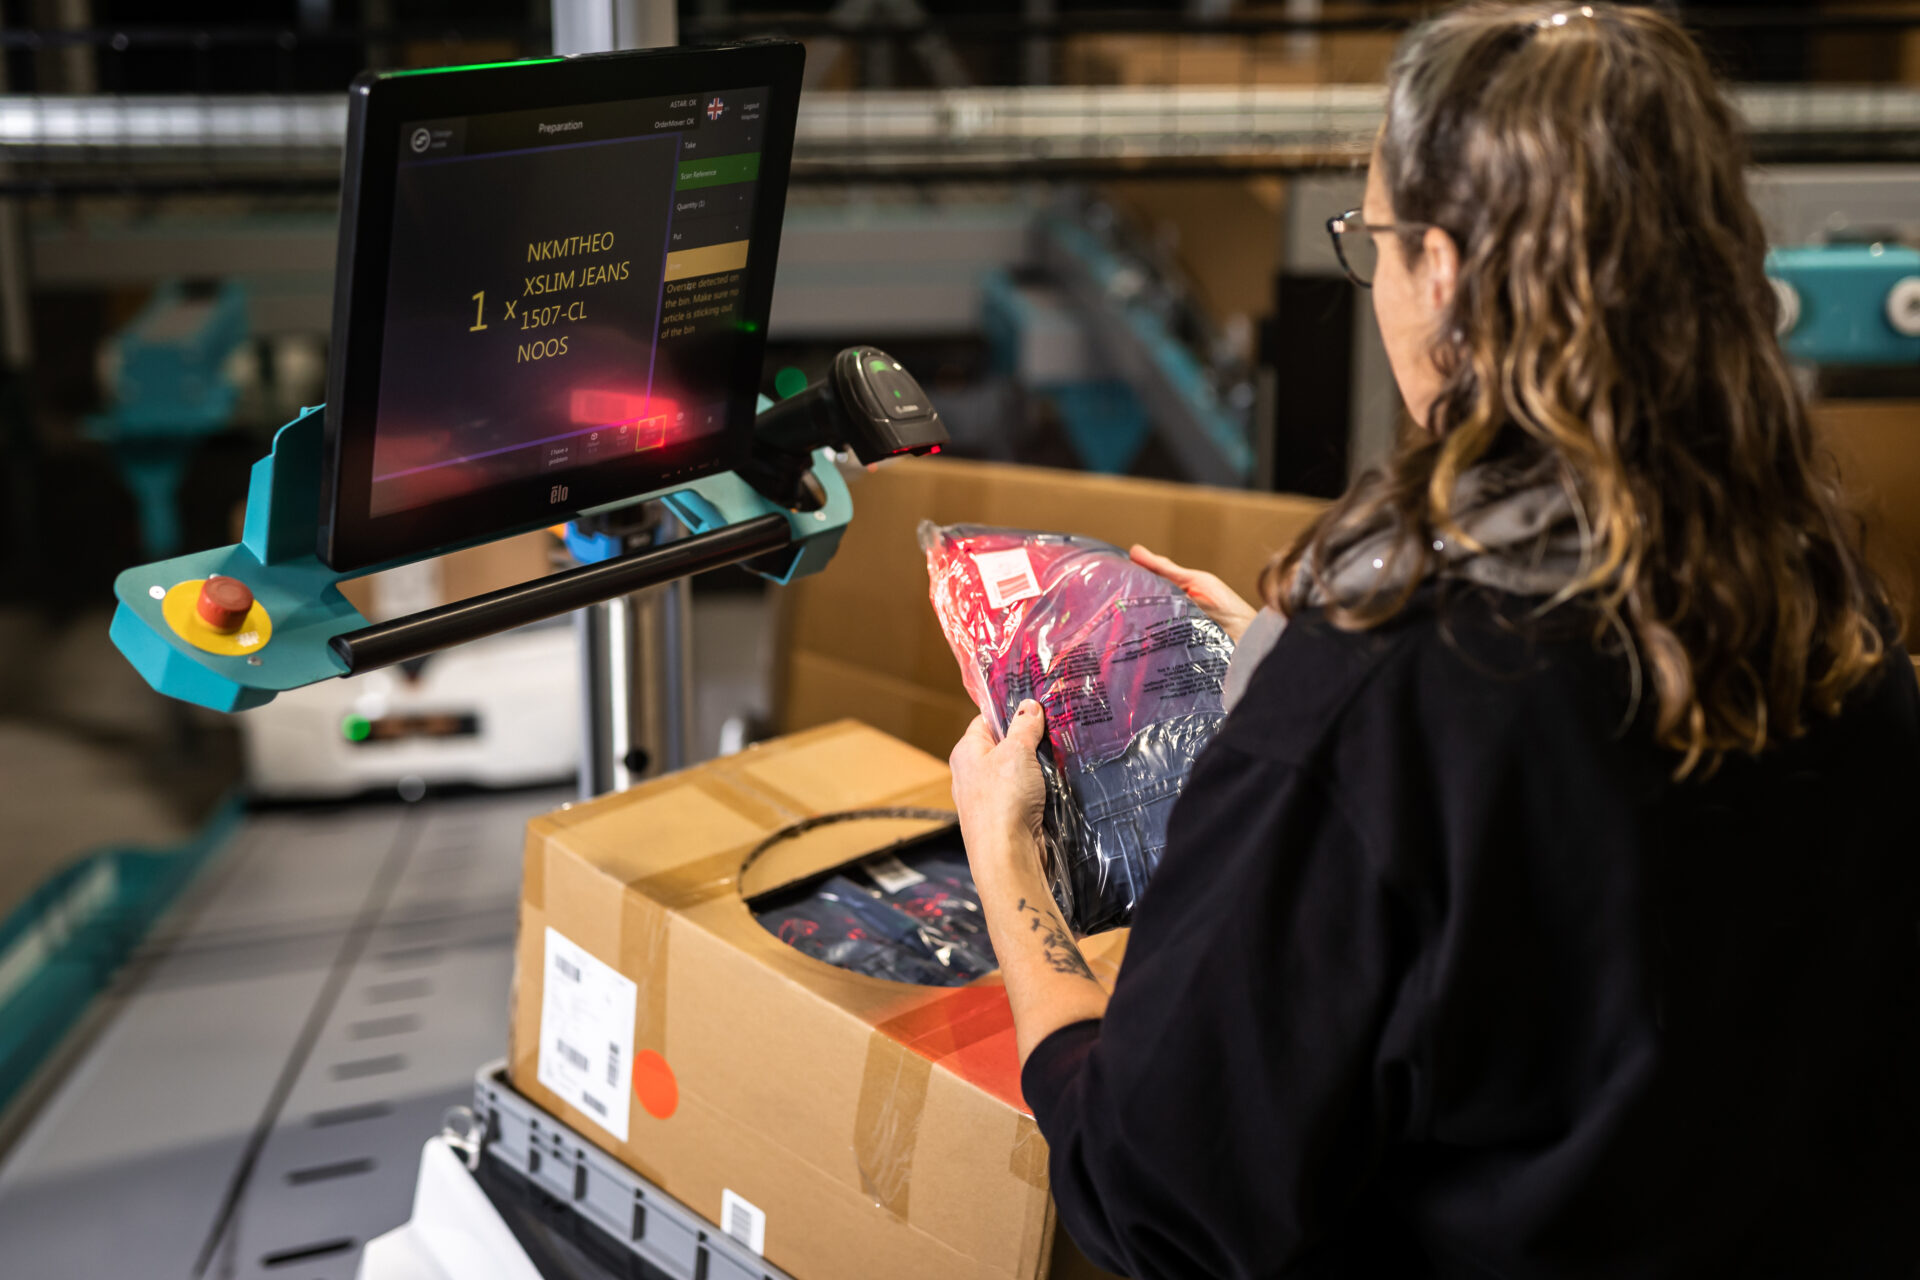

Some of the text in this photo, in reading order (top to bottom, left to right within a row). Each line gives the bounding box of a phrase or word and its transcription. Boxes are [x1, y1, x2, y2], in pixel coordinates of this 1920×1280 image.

[538, 120, 583, 135] Preparation
[680, 170, 717, 180] Scan Reference
[676, 202, 698, 212] Quantity
[527, 231, 615, 264] NKMTHEO
[523, 260, 631, 297] XSLIM JEANS
[666, 274, 740, 294] Oversize detected on
[665, 299, 677, 309] the
[693, 293, 712, 304] Make
[713, 290, 728, 300] sure
[729, 288, 740, 298] no
[469, 290, 488, 332] 1
[520, 301, 588, 331] 1507-CL
[663, 303, 734, 324] article is sticking out
[661, 325, 696, 339] of the bin
[517, 336, 569, 364] NOOS
[548, 456, 569, 466] problem
